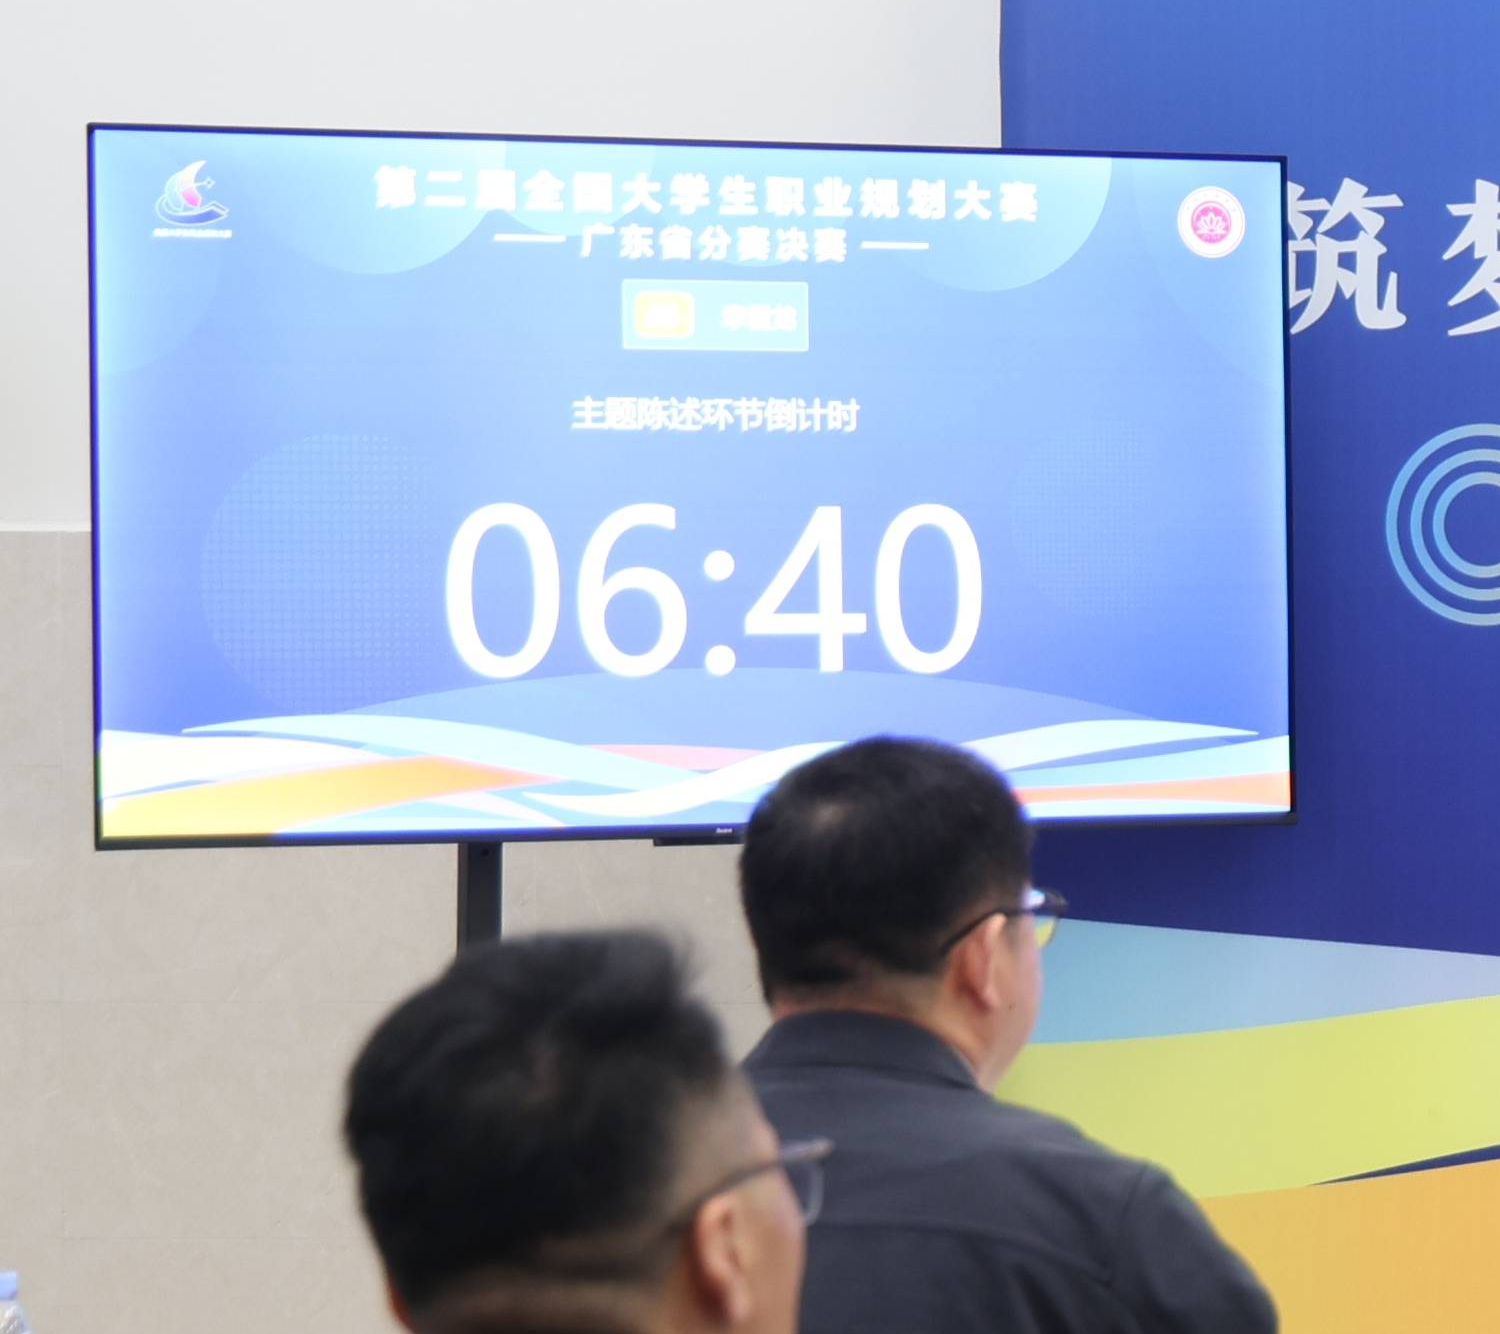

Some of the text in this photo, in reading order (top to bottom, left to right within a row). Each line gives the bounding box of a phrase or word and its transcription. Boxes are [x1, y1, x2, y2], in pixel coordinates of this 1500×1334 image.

[570, 394, 861, 434] 主题陈述环节倒计时
[443, 500, 985, 679] 06:40
